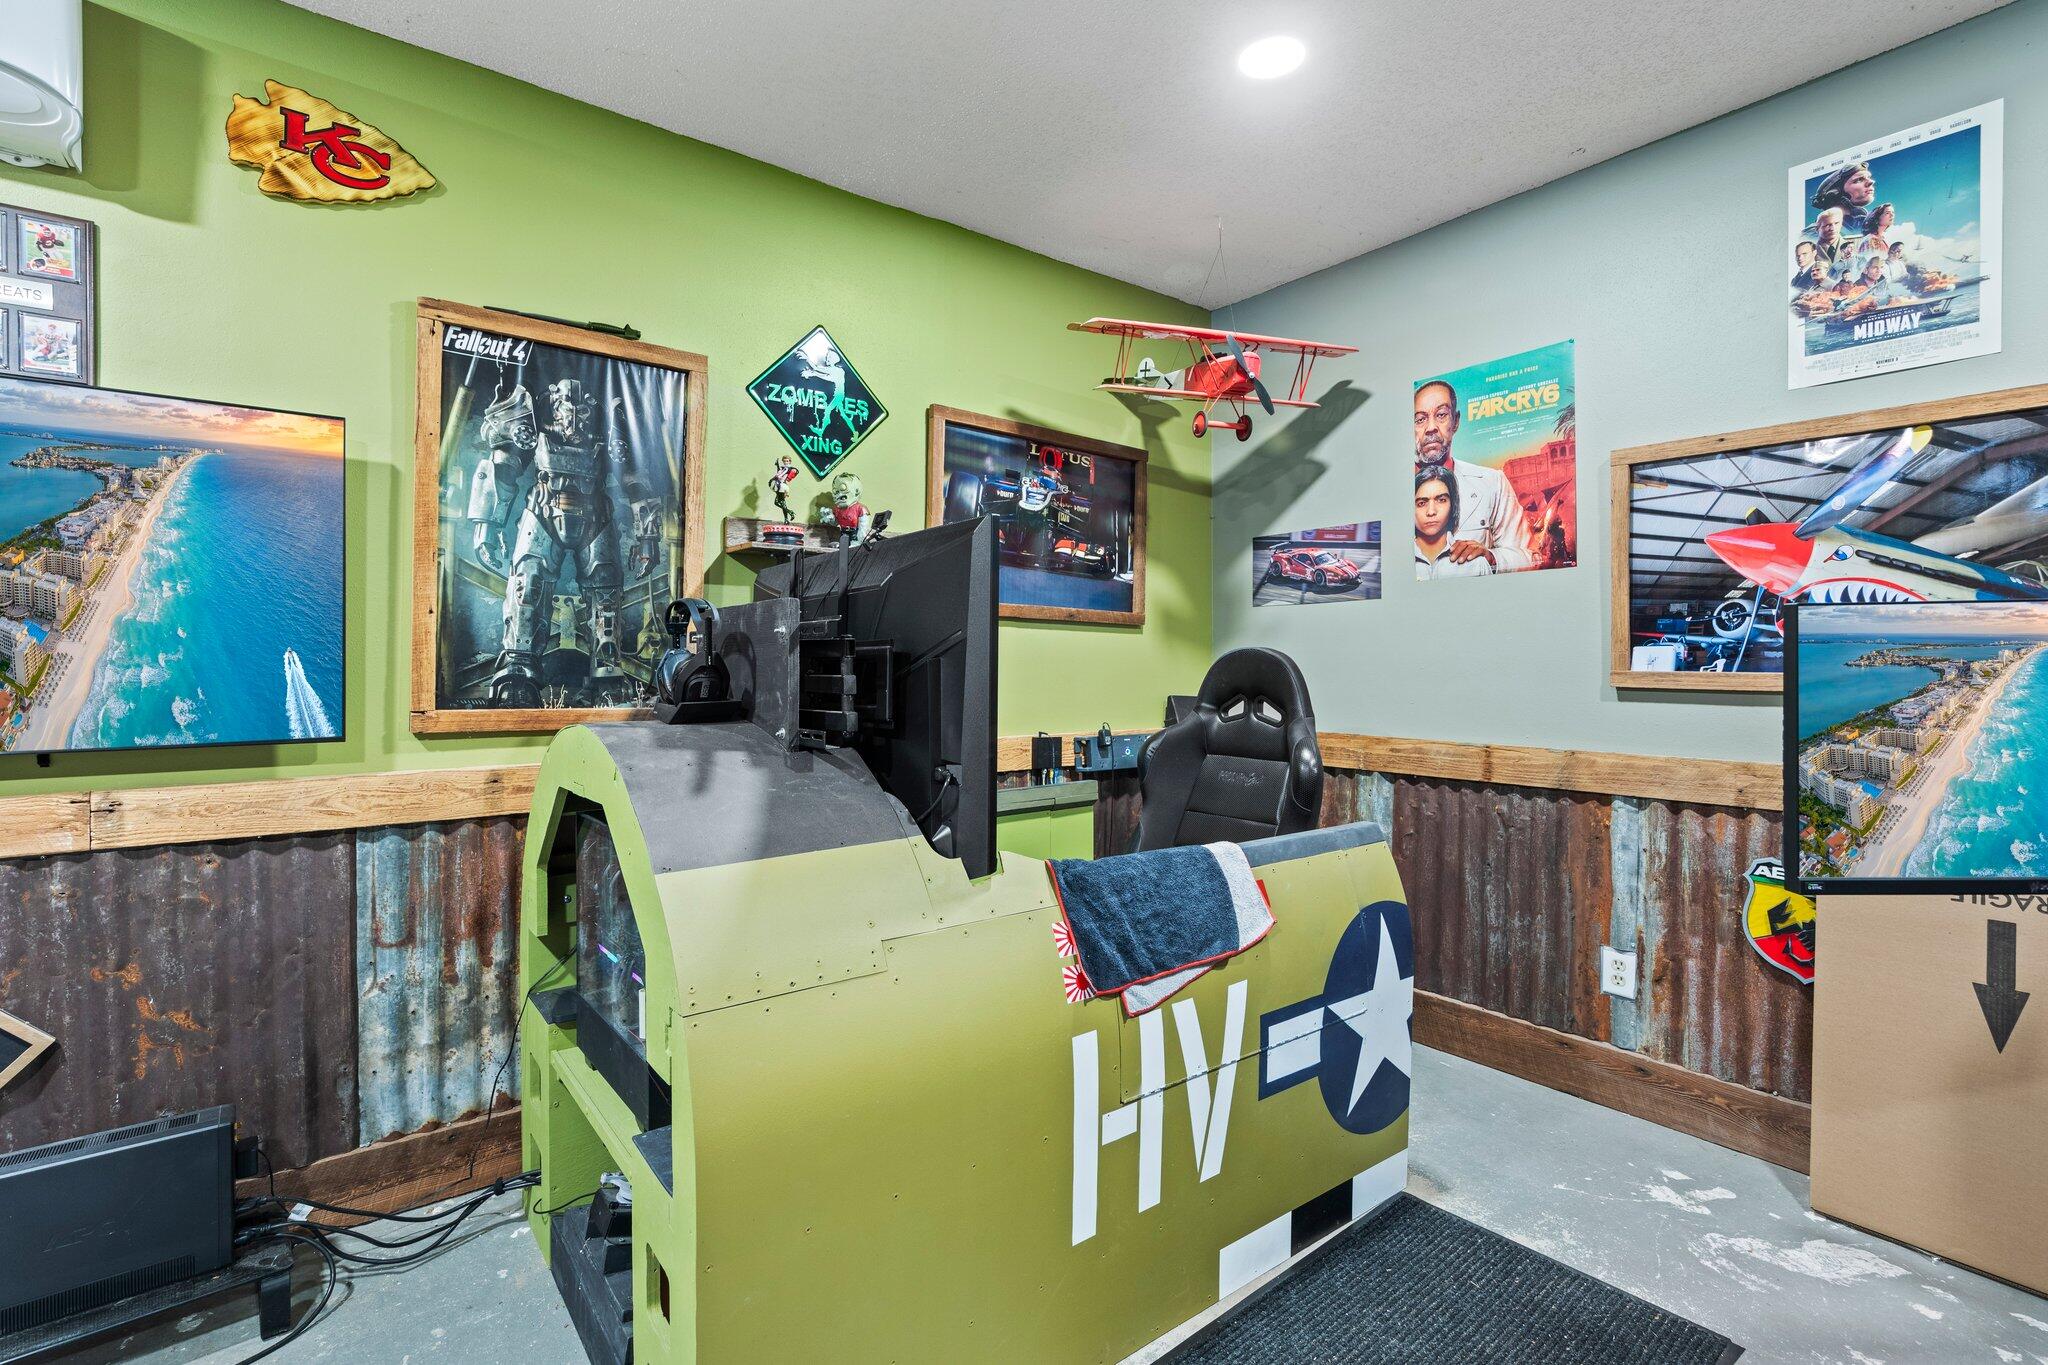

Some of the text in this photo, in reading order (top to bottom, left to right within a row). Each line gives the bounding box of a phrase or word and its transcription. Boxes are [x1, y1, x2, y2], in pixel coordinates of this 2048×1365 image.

[279, 105, 391, 190] KC
[0, 284, 42, 301] EATS
[1853, 311, 1922, 341] MIDWAY
[443, 325, 528, 361] Fallout 4
[801, 434, 843, 455] XING
[1029, 442, 1091, 468] LTUS
[1072, 980, 1248, 1247] HV
